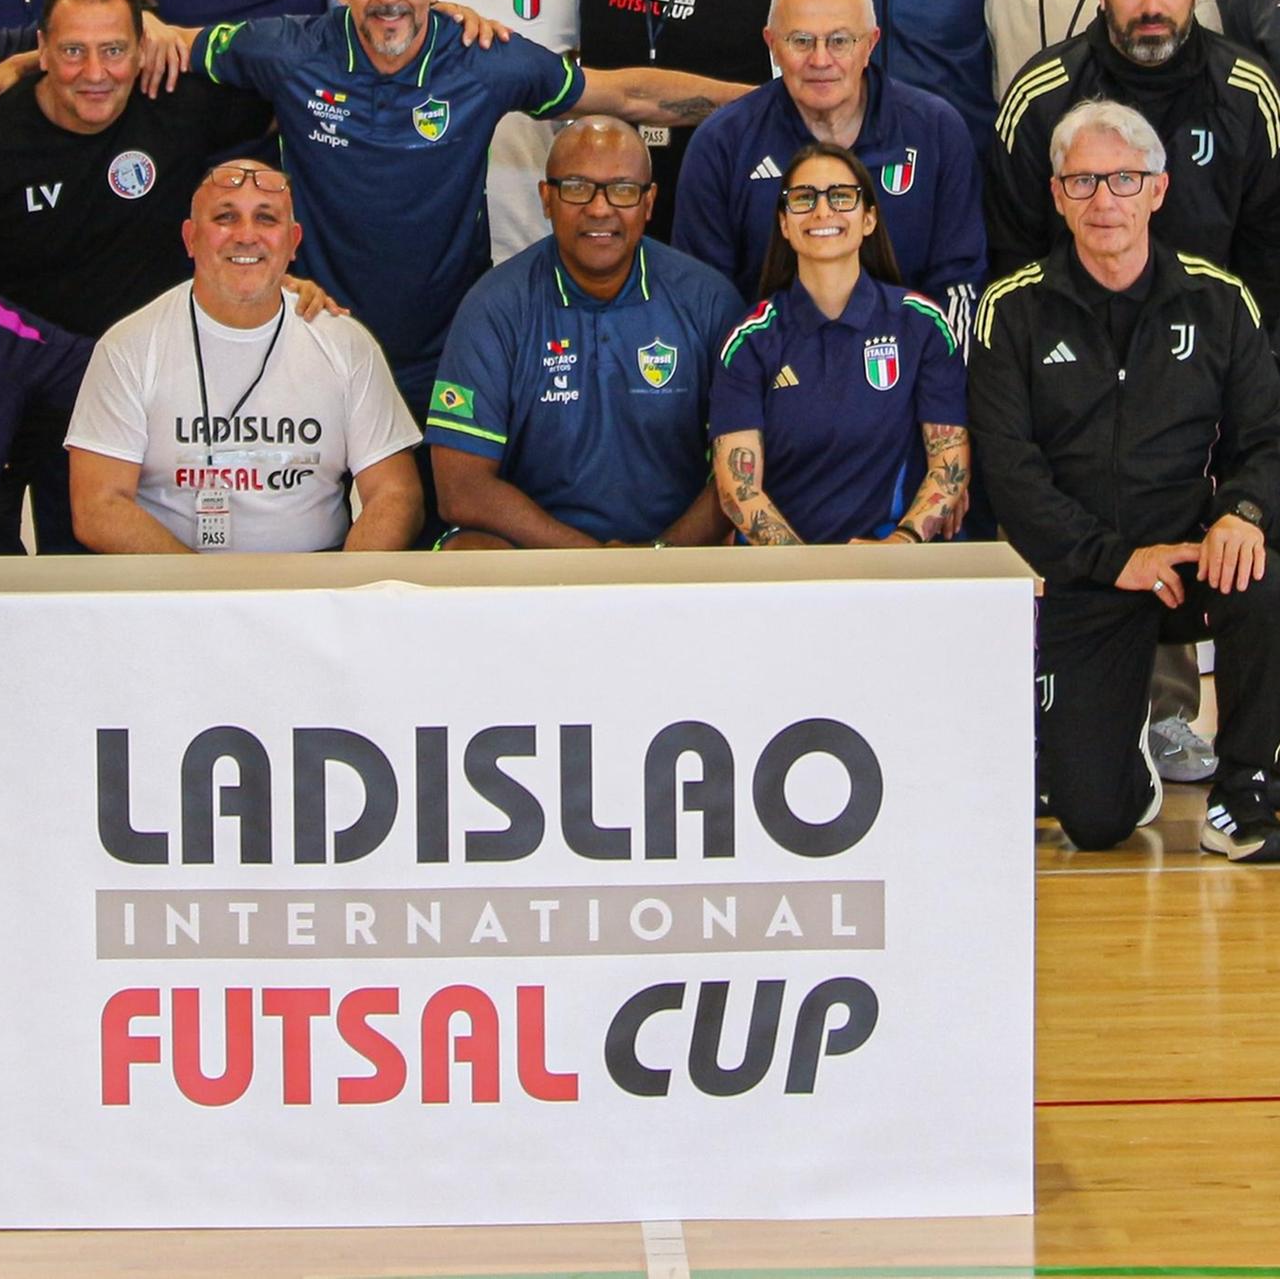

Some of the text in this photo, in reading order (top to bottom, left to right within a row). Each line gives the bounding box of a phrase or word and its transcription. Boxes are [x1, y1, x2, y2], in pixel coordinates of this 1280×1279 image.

[308, 130, 349, 148] Junpe
[26, 182, 62, 212] LV
[867, 347, 895, 358] ITALIA
[540, 390, 579, 404] Junpe
[175, 417, 322, 445] LADISLAO
[175, 468, 264, 491] FUTSAL
[202, 532, 225, 544] PASS
[96, 718, 883, 865] LADISLAO
[123, 892, 858, 947] INTERNATIONAL
[101, 977, 879, 1107] FUTSAL CUP
